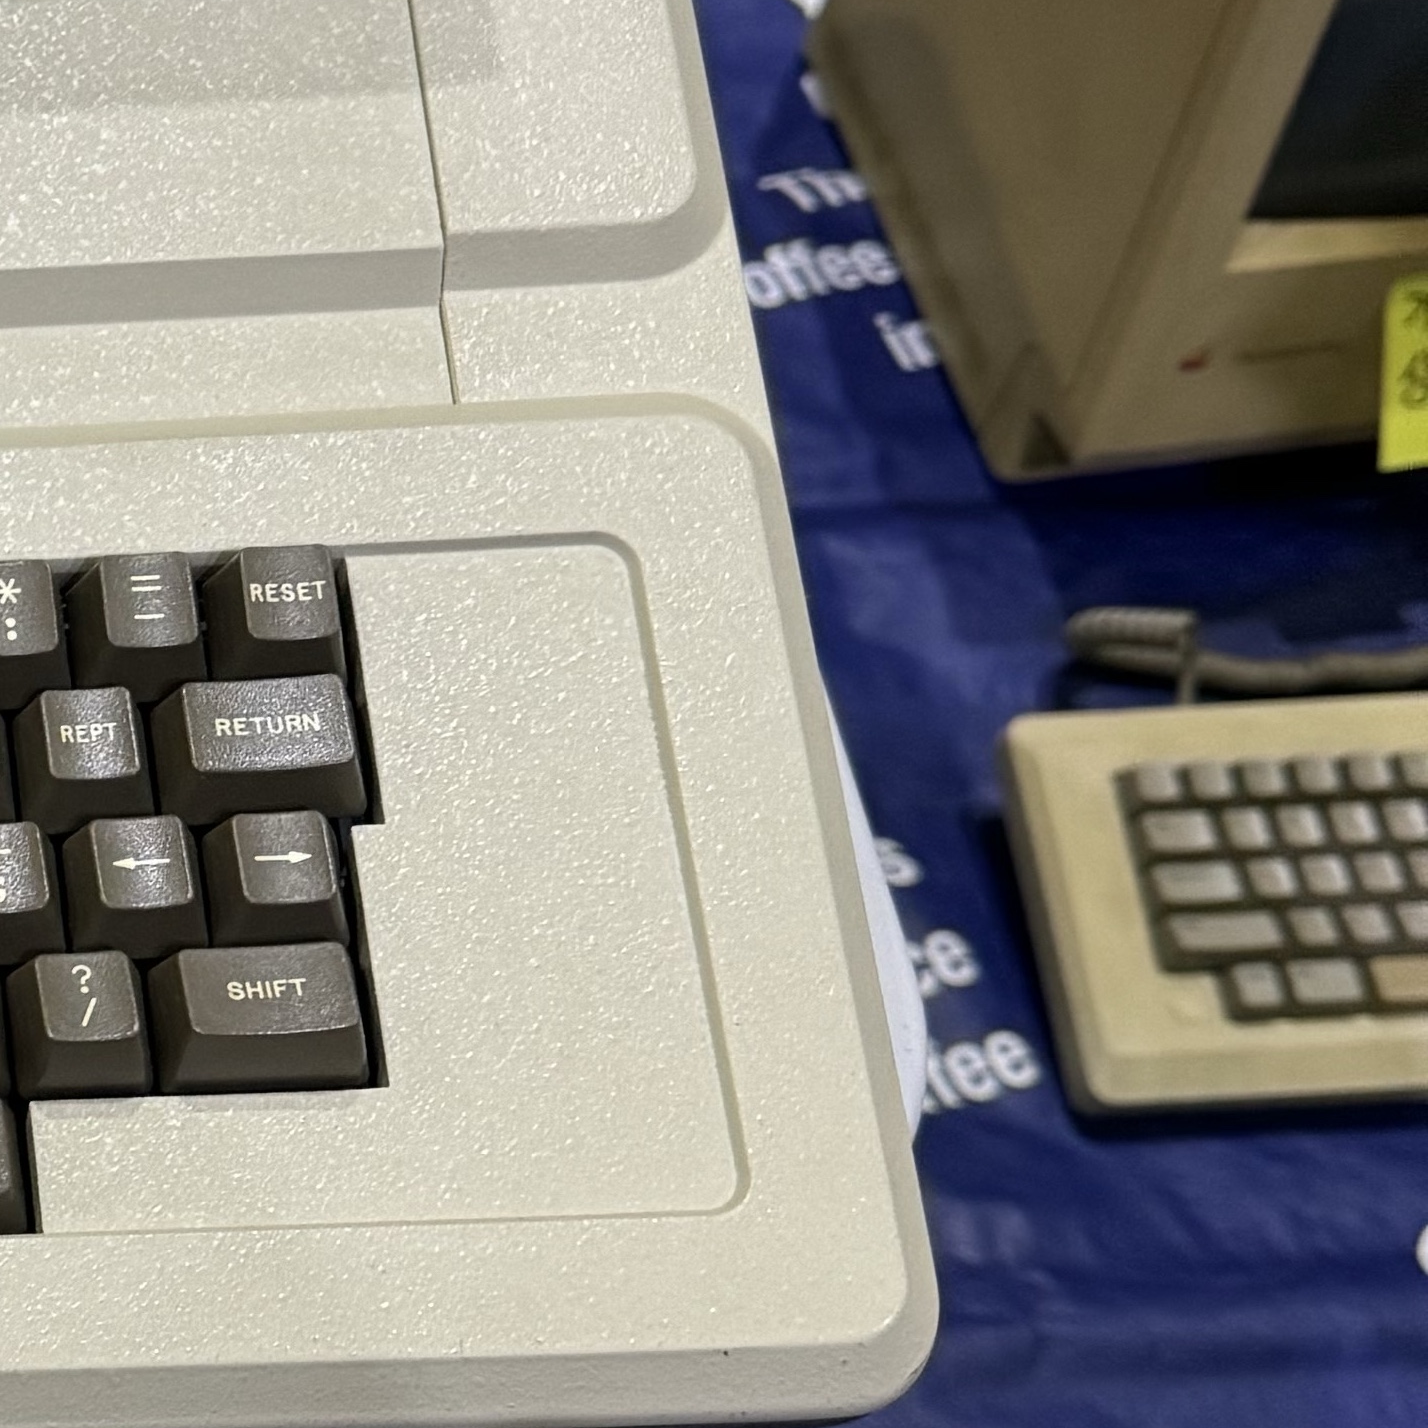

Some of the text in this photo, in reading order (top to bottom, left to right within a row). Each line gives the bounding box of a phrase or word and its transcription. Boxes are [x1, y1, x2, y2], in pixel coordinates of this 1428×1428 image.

[249, 580, 327, 603] RESET
[59, 721, 119, 744] REPT
[214, 712, 322, 737] RETURN
[70, 964, 93, 995] ?
[226, 977, 307, 1001] SHIFT
